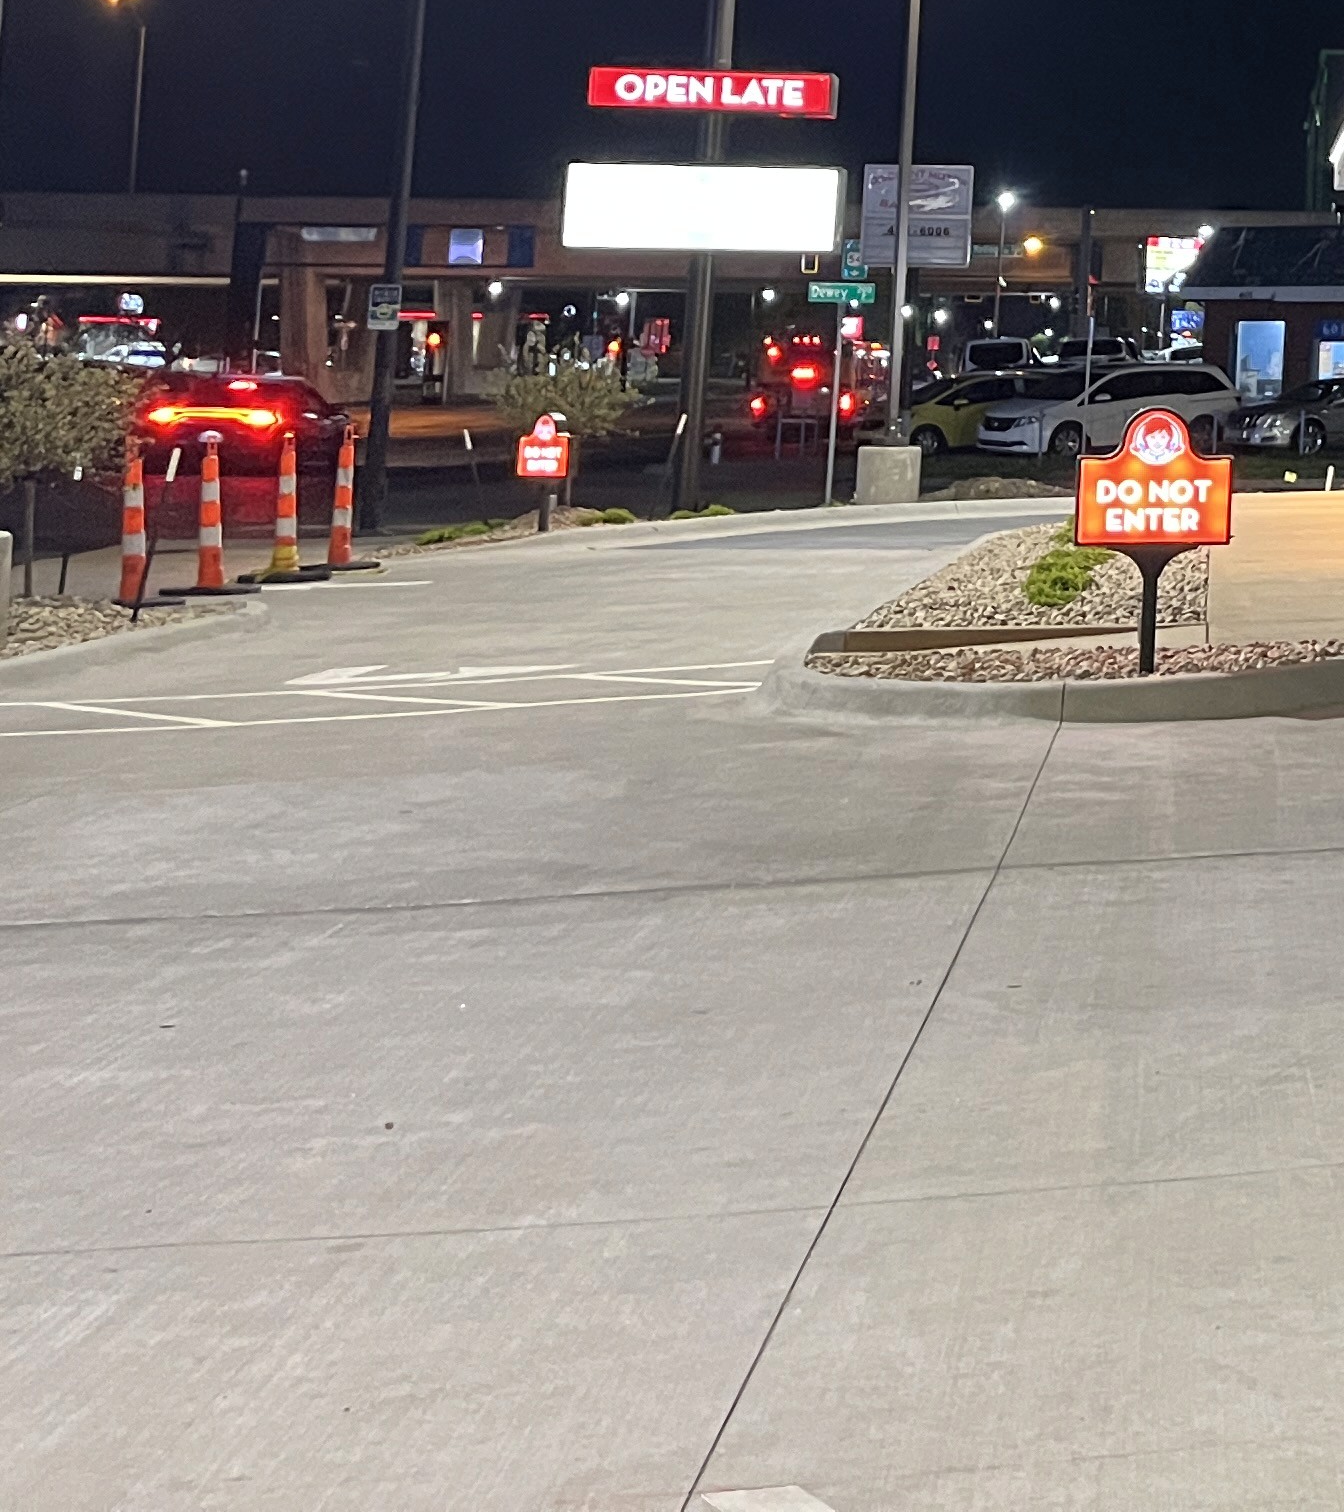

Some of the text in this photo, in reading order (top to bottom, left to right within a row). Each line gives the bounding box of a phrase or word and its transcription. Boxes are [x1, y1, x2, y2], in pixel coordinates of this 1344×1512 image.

[614, 74, 805, 106] OPEN LATE
[811, 285, 848, 301] Dewey
[1095, 479, 1213, 504] DO NOT
[1105, 507, 1200, 532] ENTER
